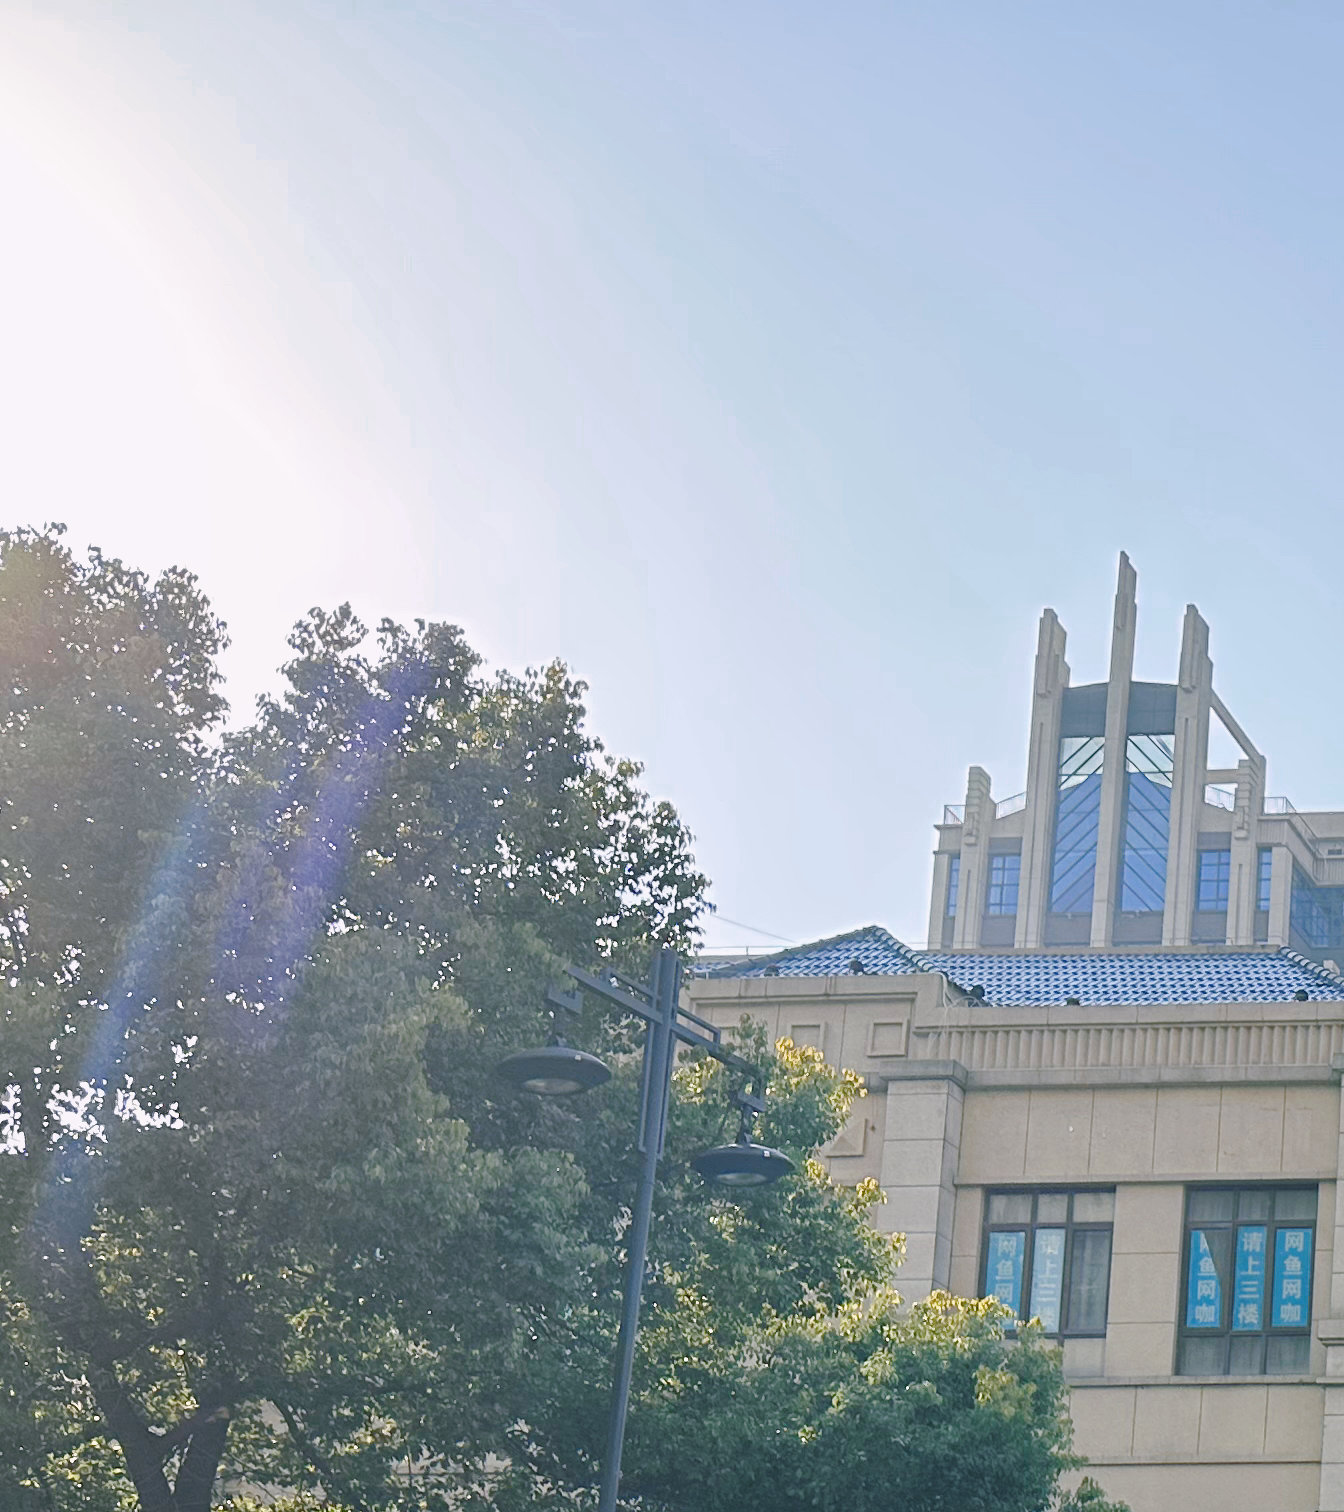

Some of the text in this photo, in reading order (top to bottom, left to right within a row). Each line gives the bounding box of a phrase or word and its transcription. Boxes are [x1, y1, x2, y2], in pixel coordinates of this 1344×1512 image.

[1237, 1233, 1263, 1324] 请上三楼
[1279, 1232, 1306, 1323] 网鱼网咖
